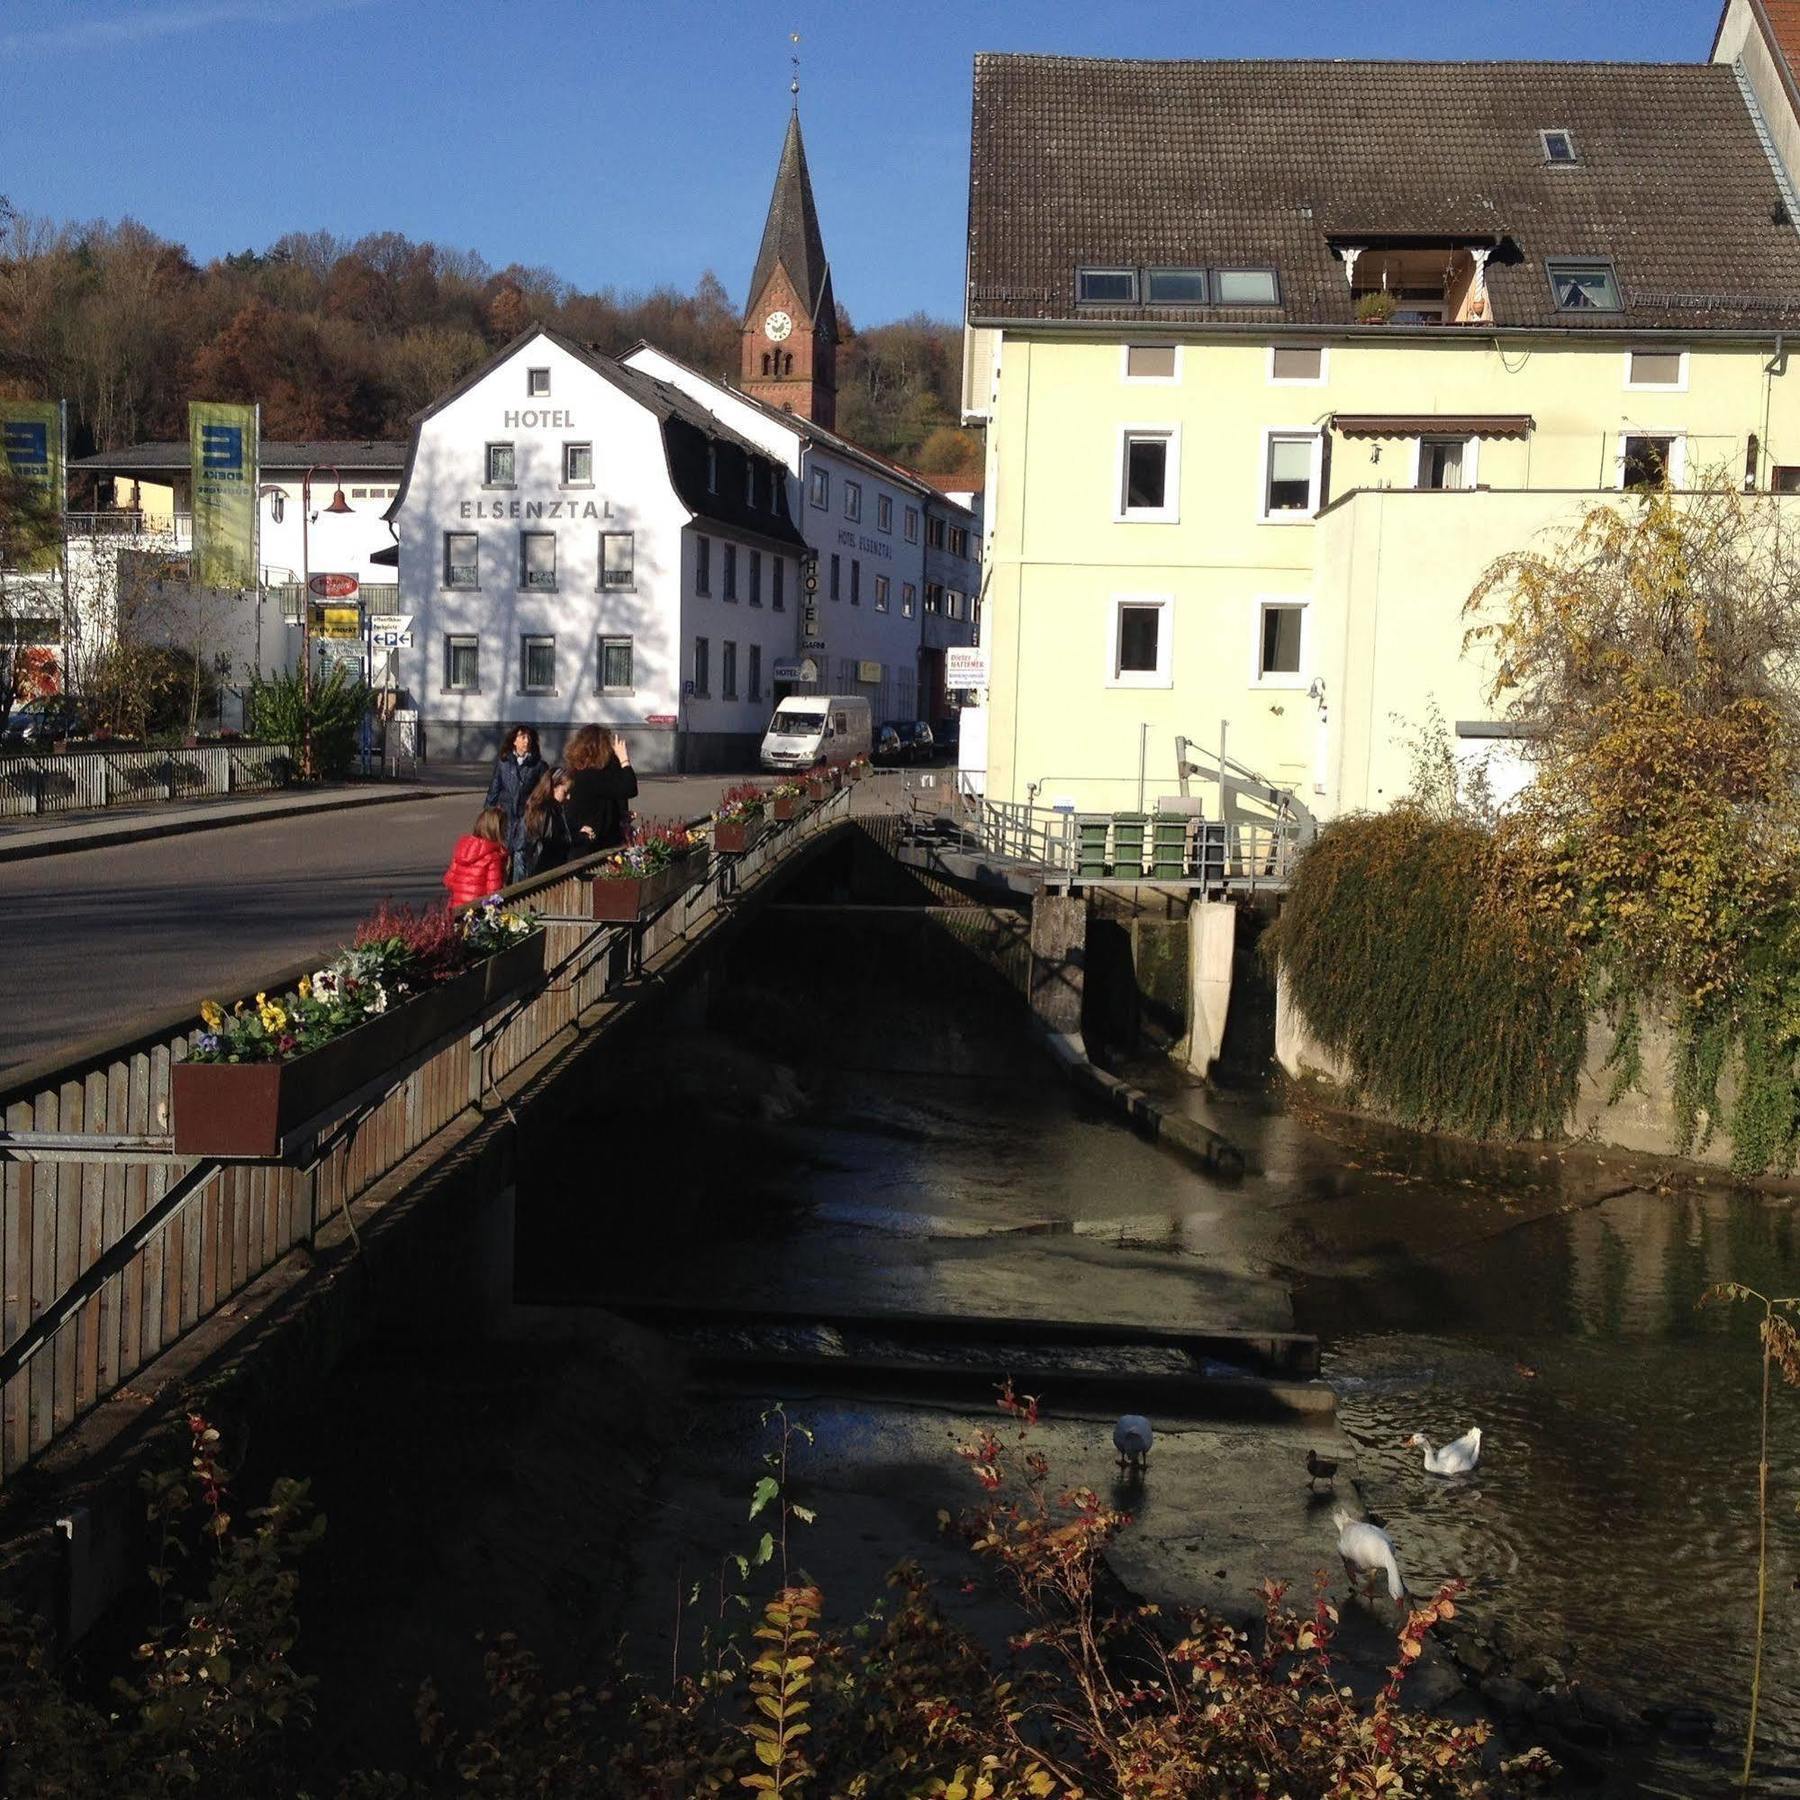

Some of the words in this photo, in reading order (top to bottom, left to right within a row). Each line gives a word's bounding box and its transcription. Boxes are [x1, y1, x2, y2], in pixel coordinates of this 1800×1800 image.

[504, 410, 575, 428] HOTEL
[460, 501, 614, 519] ELSENZTAL
[839, 530, 855, 547] HOTEL
[805, 561, 817, 636] HOTEL
[386, 633, 396, 645] P
